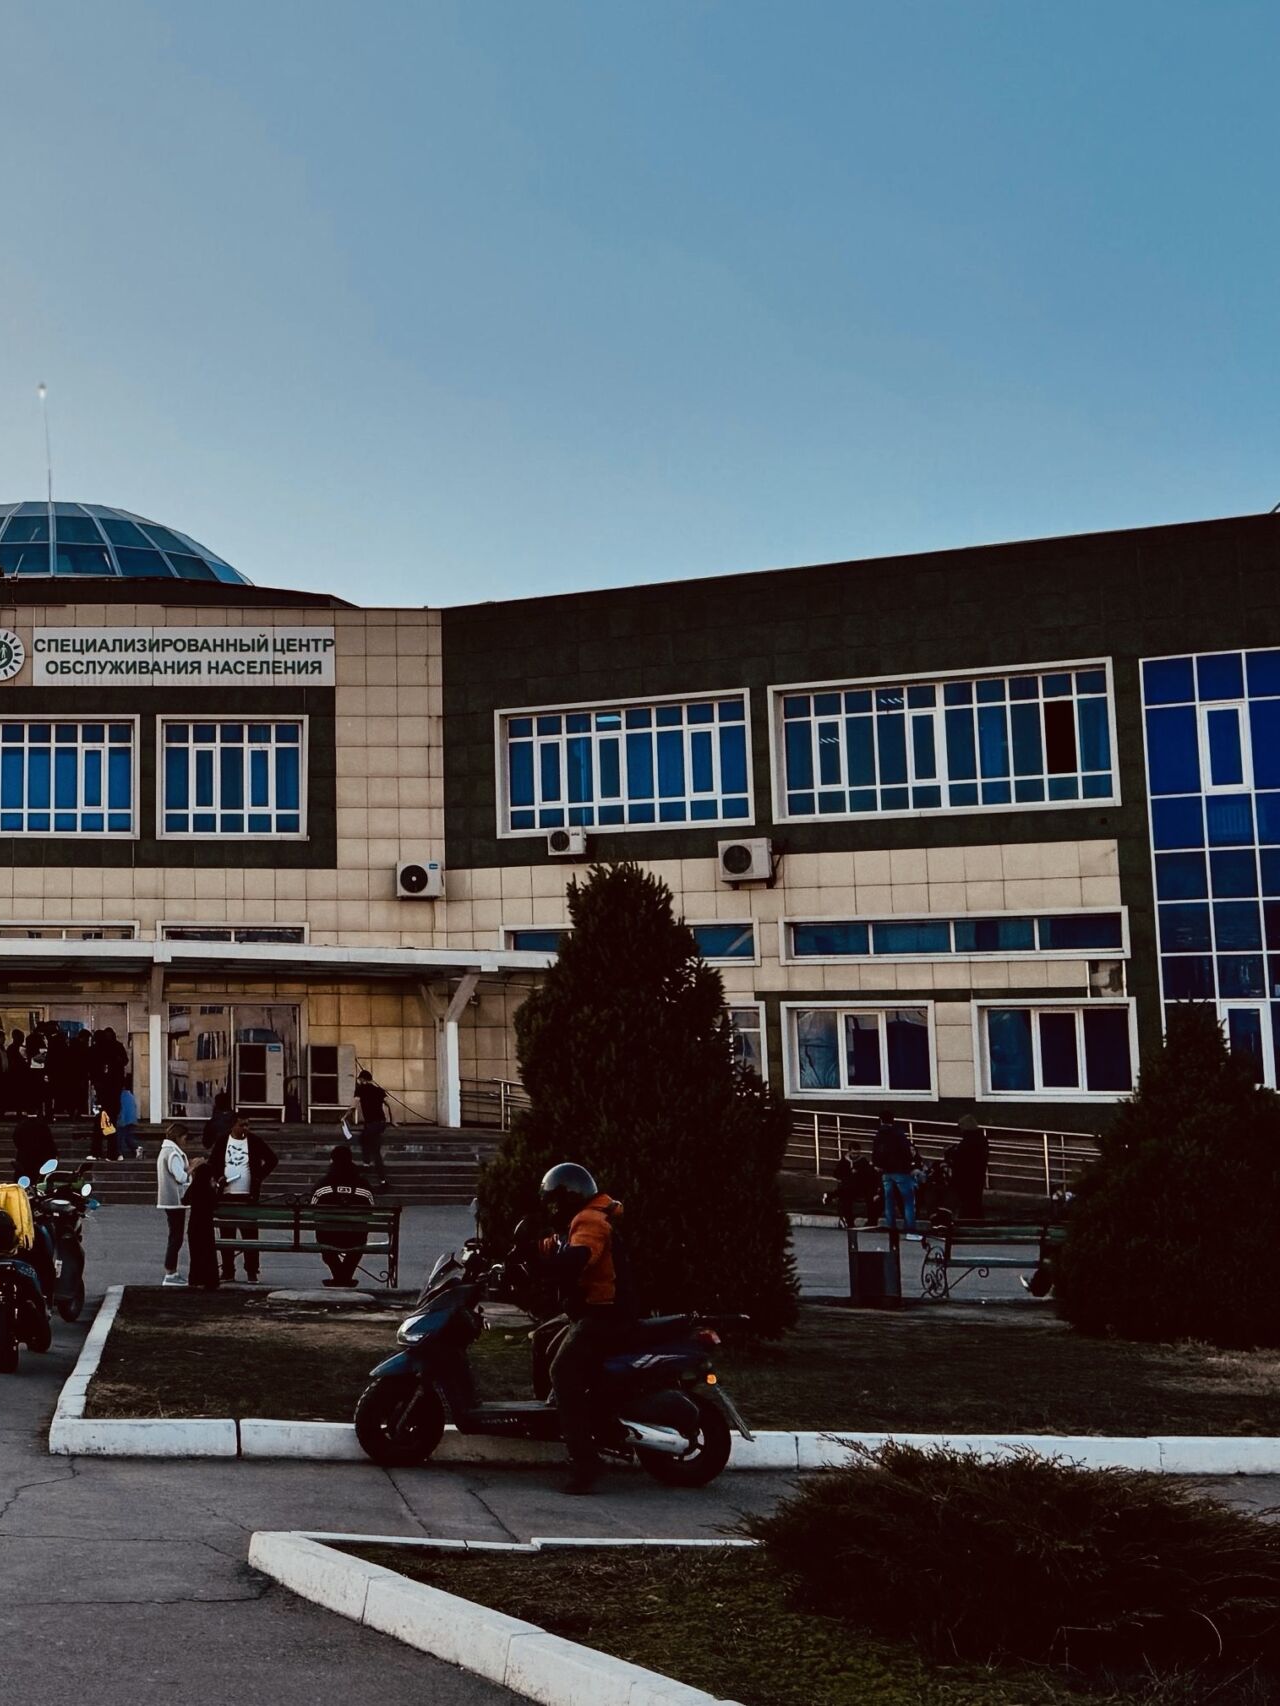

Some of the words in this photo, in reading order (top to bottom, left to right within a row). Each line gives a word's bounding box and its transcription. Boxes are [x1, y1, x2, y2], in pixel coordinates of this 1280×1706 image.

[34, 634, 269, 655] СПЕЦИАЛИЗИРОВАННЫЙ
[272, 637, 335, 655] ЦЕНТР
[45, 660, 202, 675] ОБСЛУЖИВАНИЯ
[207, 660, 323, 675] НАСЕЛЕНИЯ
